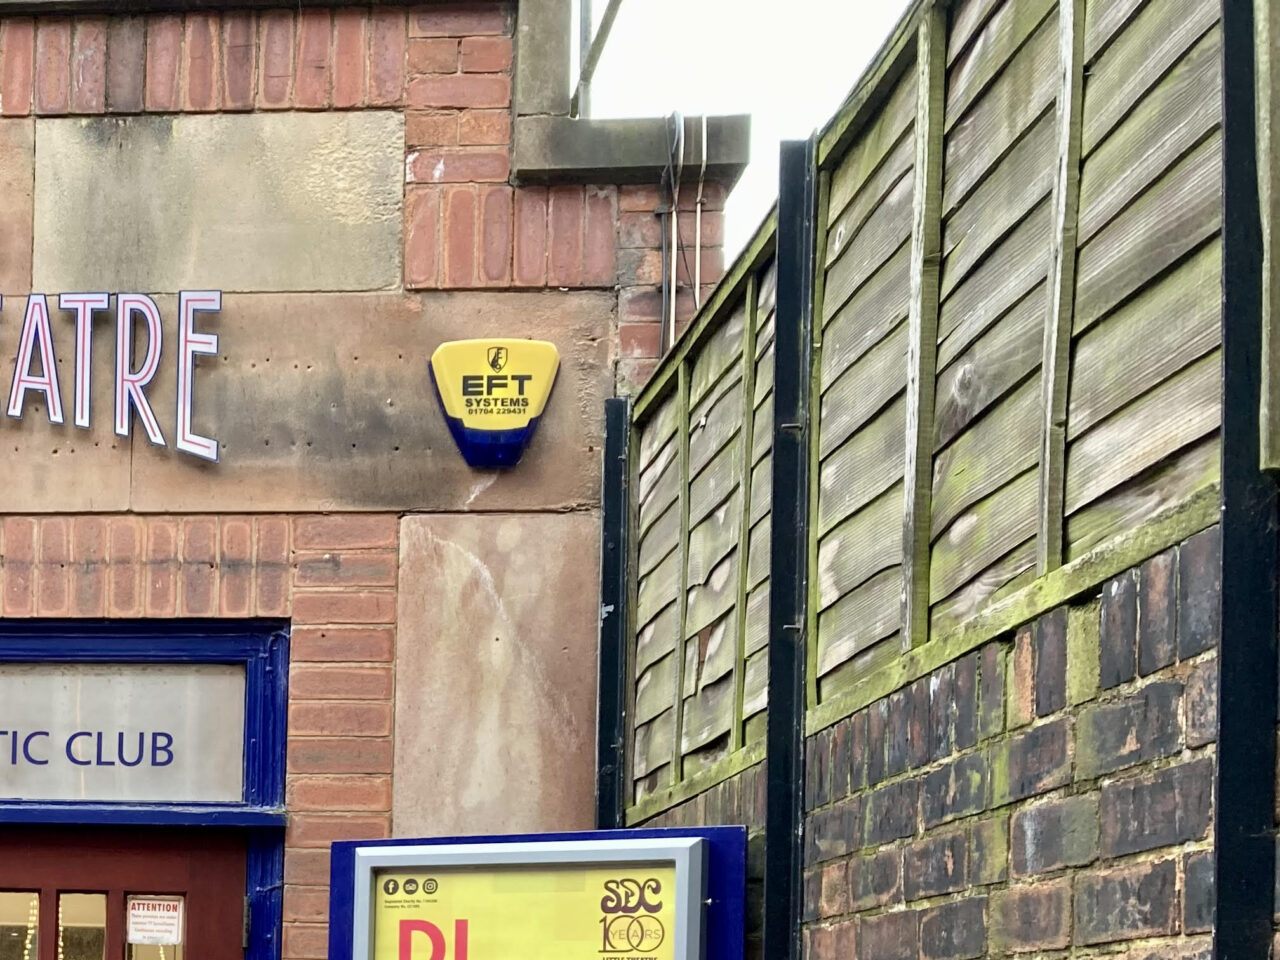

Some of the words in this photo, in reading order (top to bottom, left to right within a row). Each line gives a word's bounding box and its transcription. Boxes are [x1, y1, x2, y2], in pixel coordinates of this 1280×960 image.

[462, 375, 532, 396] EFT
[465, 398, 529, 407] SYSTEMS
[64, 731, 174, 768] CLUB
[600, 878, 663, 914] SDC
[131, 903, 178, 912] ATTENTION
[610, 929, 662, 940] YEARS
